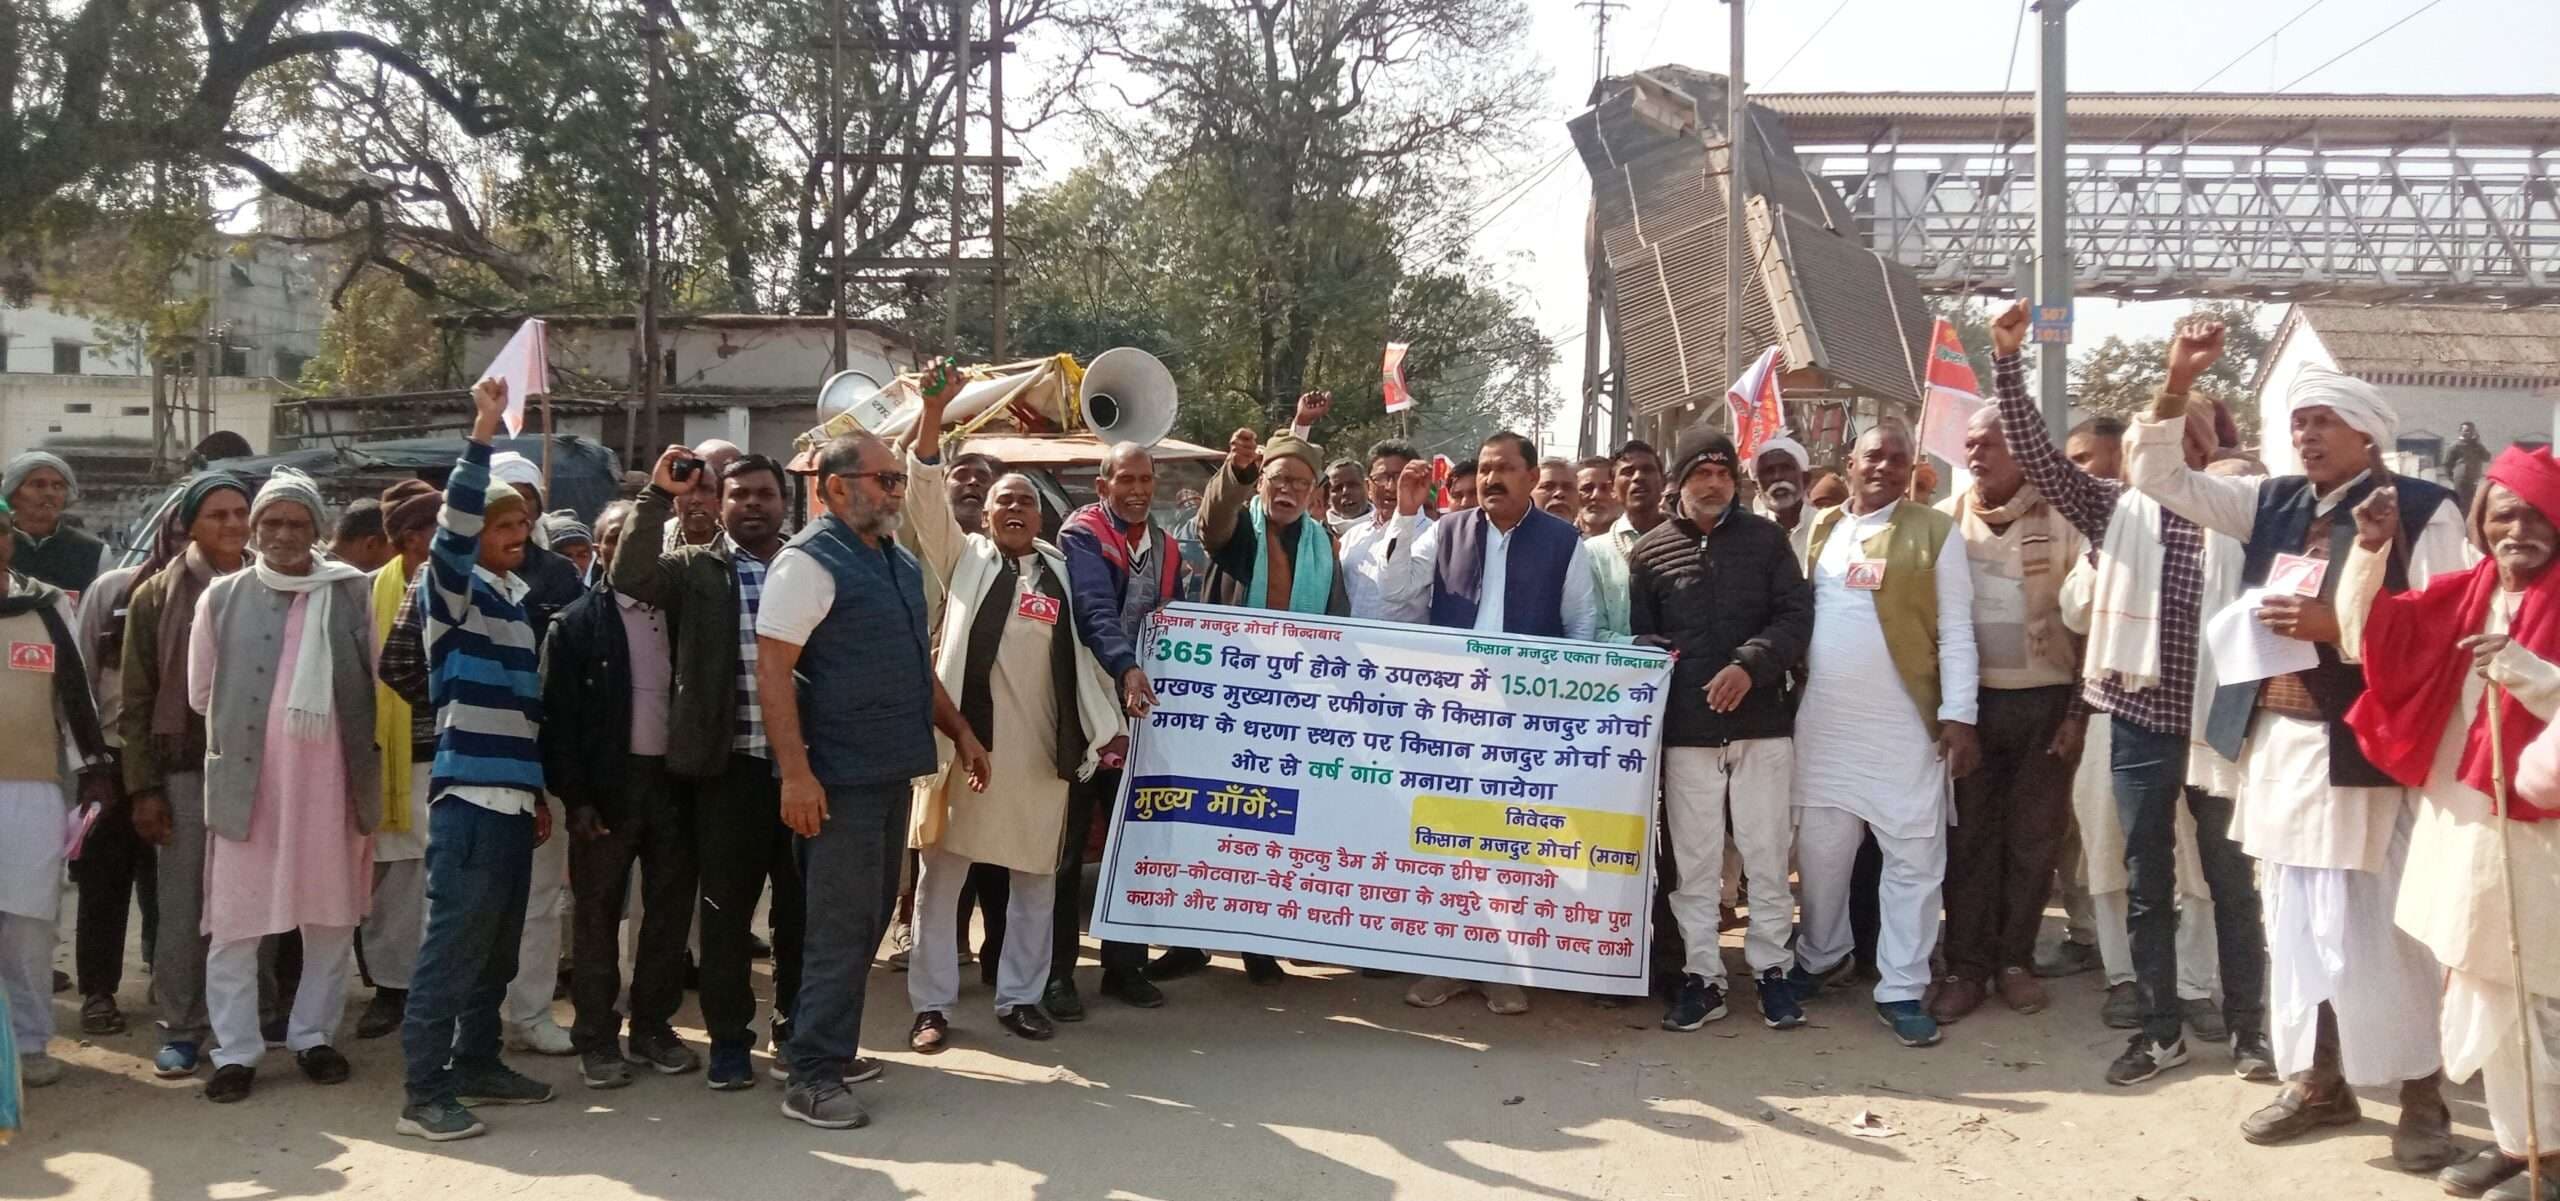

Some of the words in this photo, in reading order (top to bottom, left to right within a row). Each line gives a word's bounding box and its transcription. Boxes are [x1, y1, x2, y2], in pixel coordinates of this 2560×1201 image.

[1152, 613, 1195, 628] किसान
[1200, 618, 1240, 636] मजदुर
[1244, 620, 1279, 636] मोर्चा
[1283, 624, 1343, 641] जिन्दाबाद
[1156, 638, 1213, 665] 365
[1221, 646, 1261, 669] दिन
[1267, 651, 1305, 679] पुर्ण
[1310, 655, 1350, 679] होने
[1357, 658, 1379, 681] के
[1384, 666, 1464, 689] उपलक्ष्य
[1470, 668, 1492, 692] में
[1501, 674, 1620, 703] 15.01.2026
[1628, 683, 1658, 704] को
[1467, 640, 1514, 656] किसान
[1518, 647, 1560, 664] मजदुर
[1564, 651, 1600, 665] एकता
[1606, 651, 1666, 669] जिन्दाबाद
[1153, 677, 1217, 698] प्रखण्ड
[1223, 684, 1321, 710] मुख्यालय
[1328, 691, 1408, 718] रफीगंज
[1414, 698, 1436, 720] के
[1442, 700, 1516, 728] किसान
[1523, 713, 1589, 741] मजदुर
[1597, 714, 1652, 738] मोर्चा
[1152, 711, 1209, 731] मगध
[1215, 712, 1236, 733] के
[1244, 720, 1301, 741] धरणा
[1307, 727, 1357, 748] स्थल
[1363, 732, 1394, 752] पर
[1400, 731, 1475, 759] किसान
[1481, 744, 1547, 772] मजदुर
[1554, 745, 1611, 769] मोर्चा
[1618, 748, 1647, 773] की
[1232, 749, 1273, 774] ओर
[1279, 753, 1302, 776] से
[1308, 757, 1344, 780] वर्ष
[1350, 761, 1394, 785] गांठ
[1400, 771, 1474, 794] मनाया
[1480, 776, 1558, 800] जायेगा
[1134, 787, 1198, 820] मुख्य
[1505, 807, 1567, 830] निवेदक
[1217, 833, 1261, 857] मंडल
[1265, 840, 1283, 860] के
[1336, 846, 1366, 870] डैम
[1371, 851, 1389, 871] में
[1395, 858, 1446, 876] फाटक
[1496, 868, 1559, 889] लगाओ
[1416, 827, 1473, 849] किसान
[1479, 836, 1533, 860] मजदुर
[1538, 839, 1581, 860] मोर्चा
[1126, 888, 1178, 907] कराओ
[1184, 889, 1218, 911] और
[1223, 897, 1272, 916] मगध
[1277, 899, 1301, 920] की
[1307, 906, 1354, 927] धरती
[1359, 913, 1385, 930] पर
[1390, 917, 1429, 936] नहर
[1434, 922, 1459, 938] का
[1463, 925, 1502, 943] लाल
[1507, 928, 1550, 949] पानी
[1555, 935, 1593, 954] जल्द
[1598, 937, 1634, 957] लाओ
[1358, 884, 1410, 903] शाखा
[1416, 886, 1434, 905] के
[1439, 890, 1483, 916] अधुरे
[1488, 896, 1528, 915] कार्य
[1534, 899, 1558, 919] को
[1608, 910, 1632, 932] पुरा
